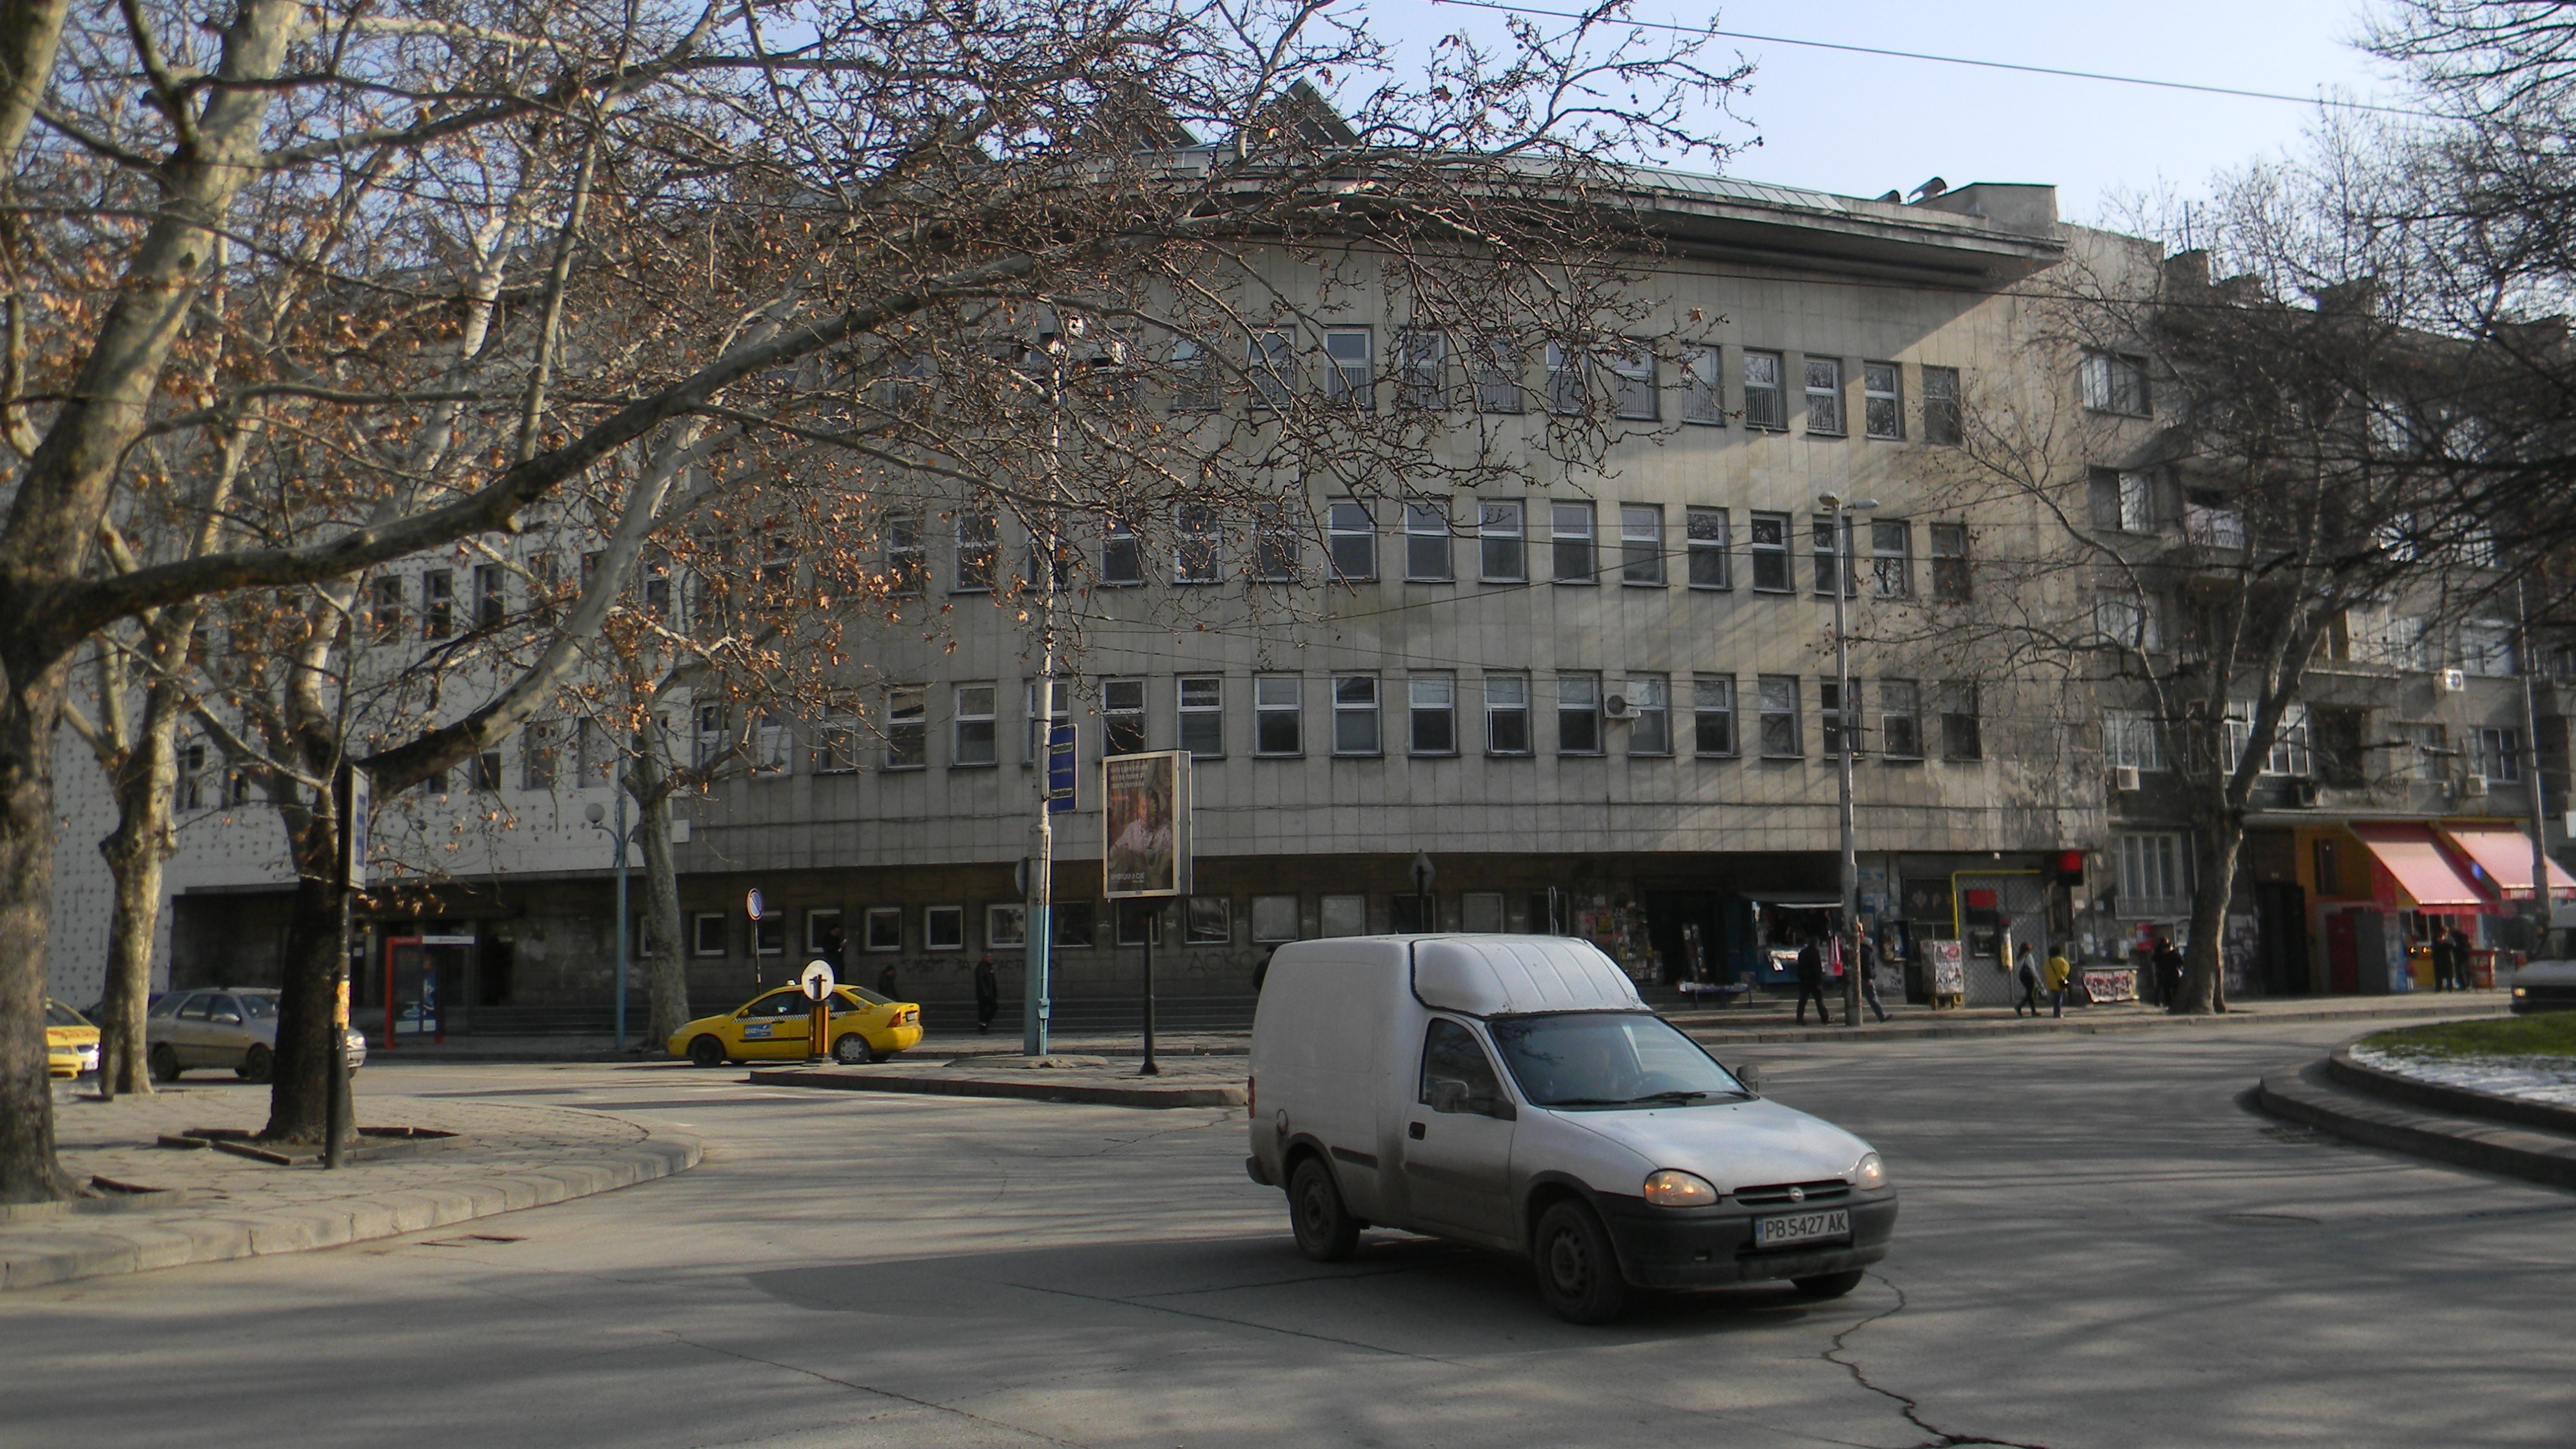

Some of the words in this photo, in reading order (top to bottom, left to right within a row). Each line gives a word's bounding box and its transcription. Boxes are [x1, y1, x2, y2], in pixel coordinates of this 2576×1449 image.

[1765, 1220, 1785, 1239] PB
[1789, 1215, 1824, 1236] 5427
[1827, 1212, 1846, 1232] AK
